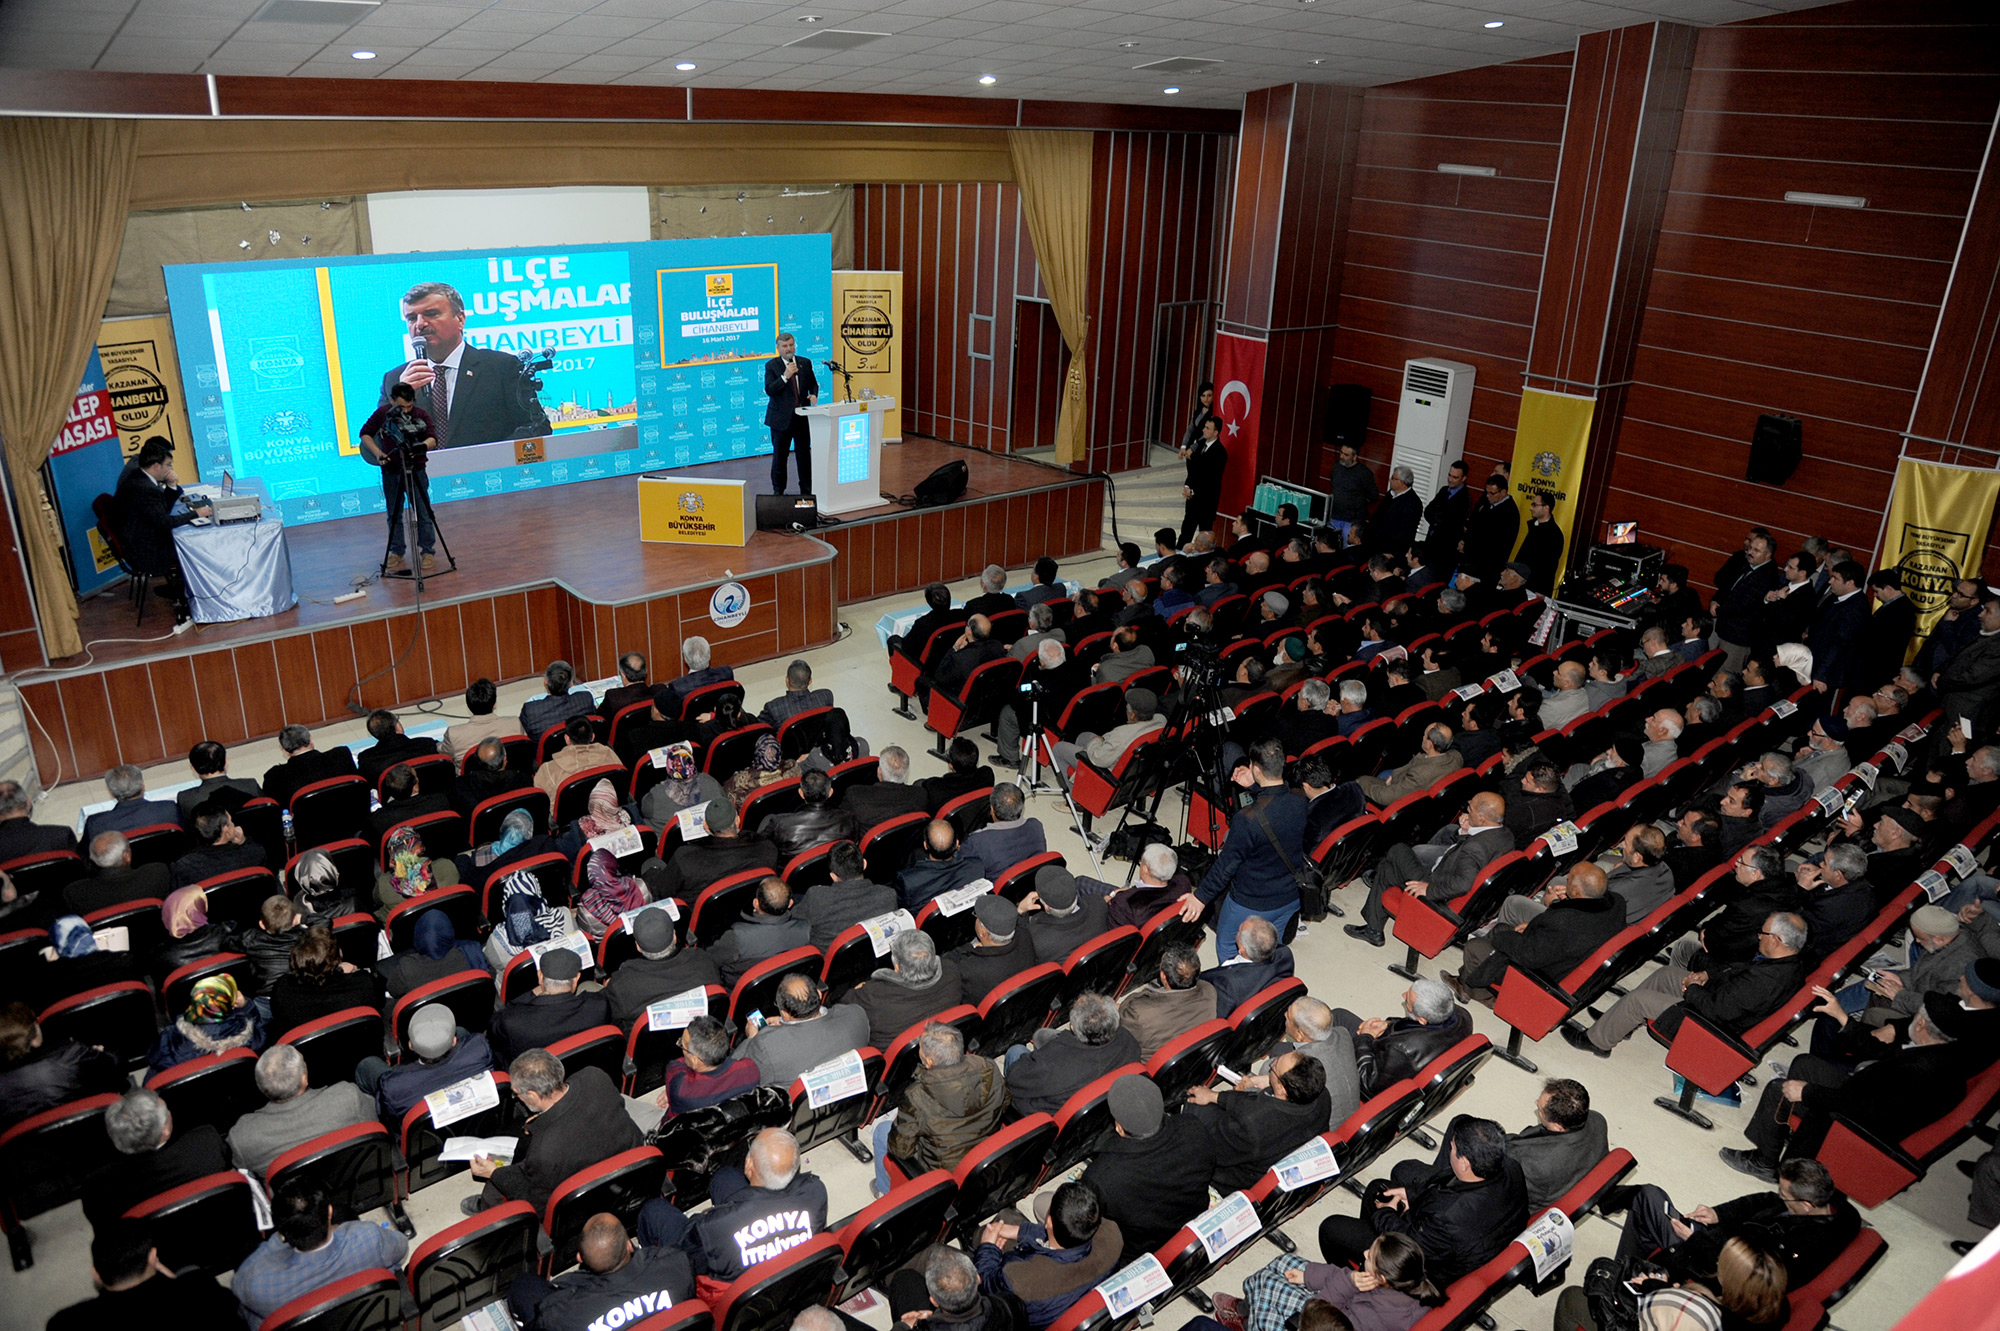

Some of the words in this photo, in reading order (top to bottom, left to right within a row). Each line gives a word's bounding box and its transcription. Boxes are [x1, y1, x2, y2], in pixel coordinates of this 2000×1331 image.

[488, 257, 571, 288] İLÇE
[399, 283, 631, 321] UŞMALA
[707, 297, 733, 309] İLÇE
[681, 307, 759, 321] BULUŞMALARI
[463, 319, 621, 351] HANBEYLİ
[692, 322, 749, 335] CİHANBEYLİ
[842, 326, 890, 336] CİHANBEYLİ
[552, 357, 596, 373] 2017
[108, 379, 148, 389] KAZANAN
[111, 389, 164, 407] ANBEYLİ
[121, 410, 149, 421] OLDU
[266, 436, 311, 448] KONYA
[1531, 477, 1555, 488] KONYA
[668, 520, 716, 531] BÜYÜKŞEHİR
[1910, 561, 1947, 573] KAZANAN
[1901, 570, 1953, 593] KONYA
[1910, 592, 1935, 604] OLDU
[733, 1210, 811, 1248] KONYA
[587, 1290, 672, 1331] KONYA
